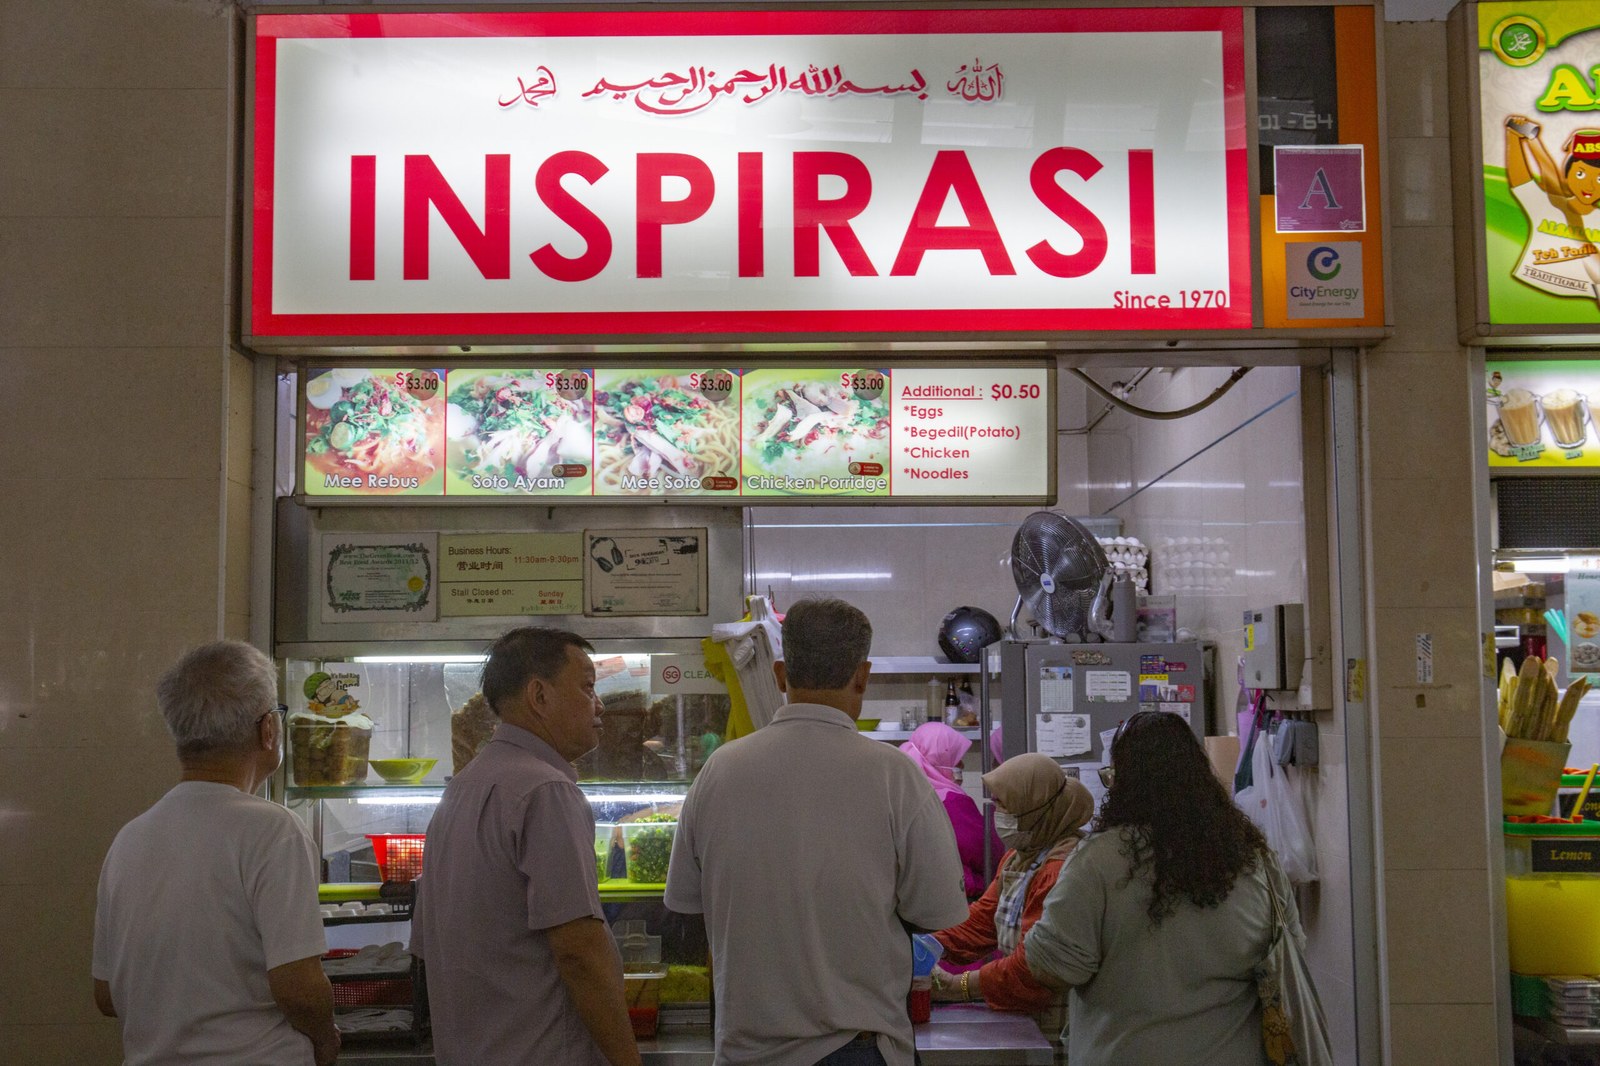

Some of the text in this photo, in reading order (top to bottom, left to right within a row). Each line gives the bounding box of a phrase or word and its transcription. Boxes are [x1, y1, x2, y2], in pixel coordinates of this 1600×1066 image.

[1298, 167, 1343, 210] A
[349, 146, 1156, 282] INSPIRASI
[1524, 267, 1588, 290] TRADITIONAL
[1113, 290, 1227, 310] Since 1970
[1290, 286, 1359, 300] CityEnergy
[407, 377, 438, 391] $3.00
[557, 377, 587, 391] $3.00
[701, 378, 732, 392] $3.00
[853, 377, 884, 391] $3.00
[901, 385, 974, 398] Additional
[991, 383, 1041, 401] $0.50
[324, 474, 419, 488] Mee Rebus
[472, 475, 565, 491] Soto Ayam
[621, 475, 659, 489] Mee
[664, 475, 701, 489] Soto
[747, 475, 815, 490] Chicken
[819, 475, 887, 491] Porridge
[448, 545, 512, 556] Business Hours:
[457, 561, 503, 571] 营业时间
[514, 555, 579, 564] 11:30am-9:30pm
[451, 588, 515, 597] Stall Closed on:
[538, 590, 564, 598] Sunday
[665, 670, 715, 680] SG CLEA
[1550, 849, 1593, 861] Lemon
